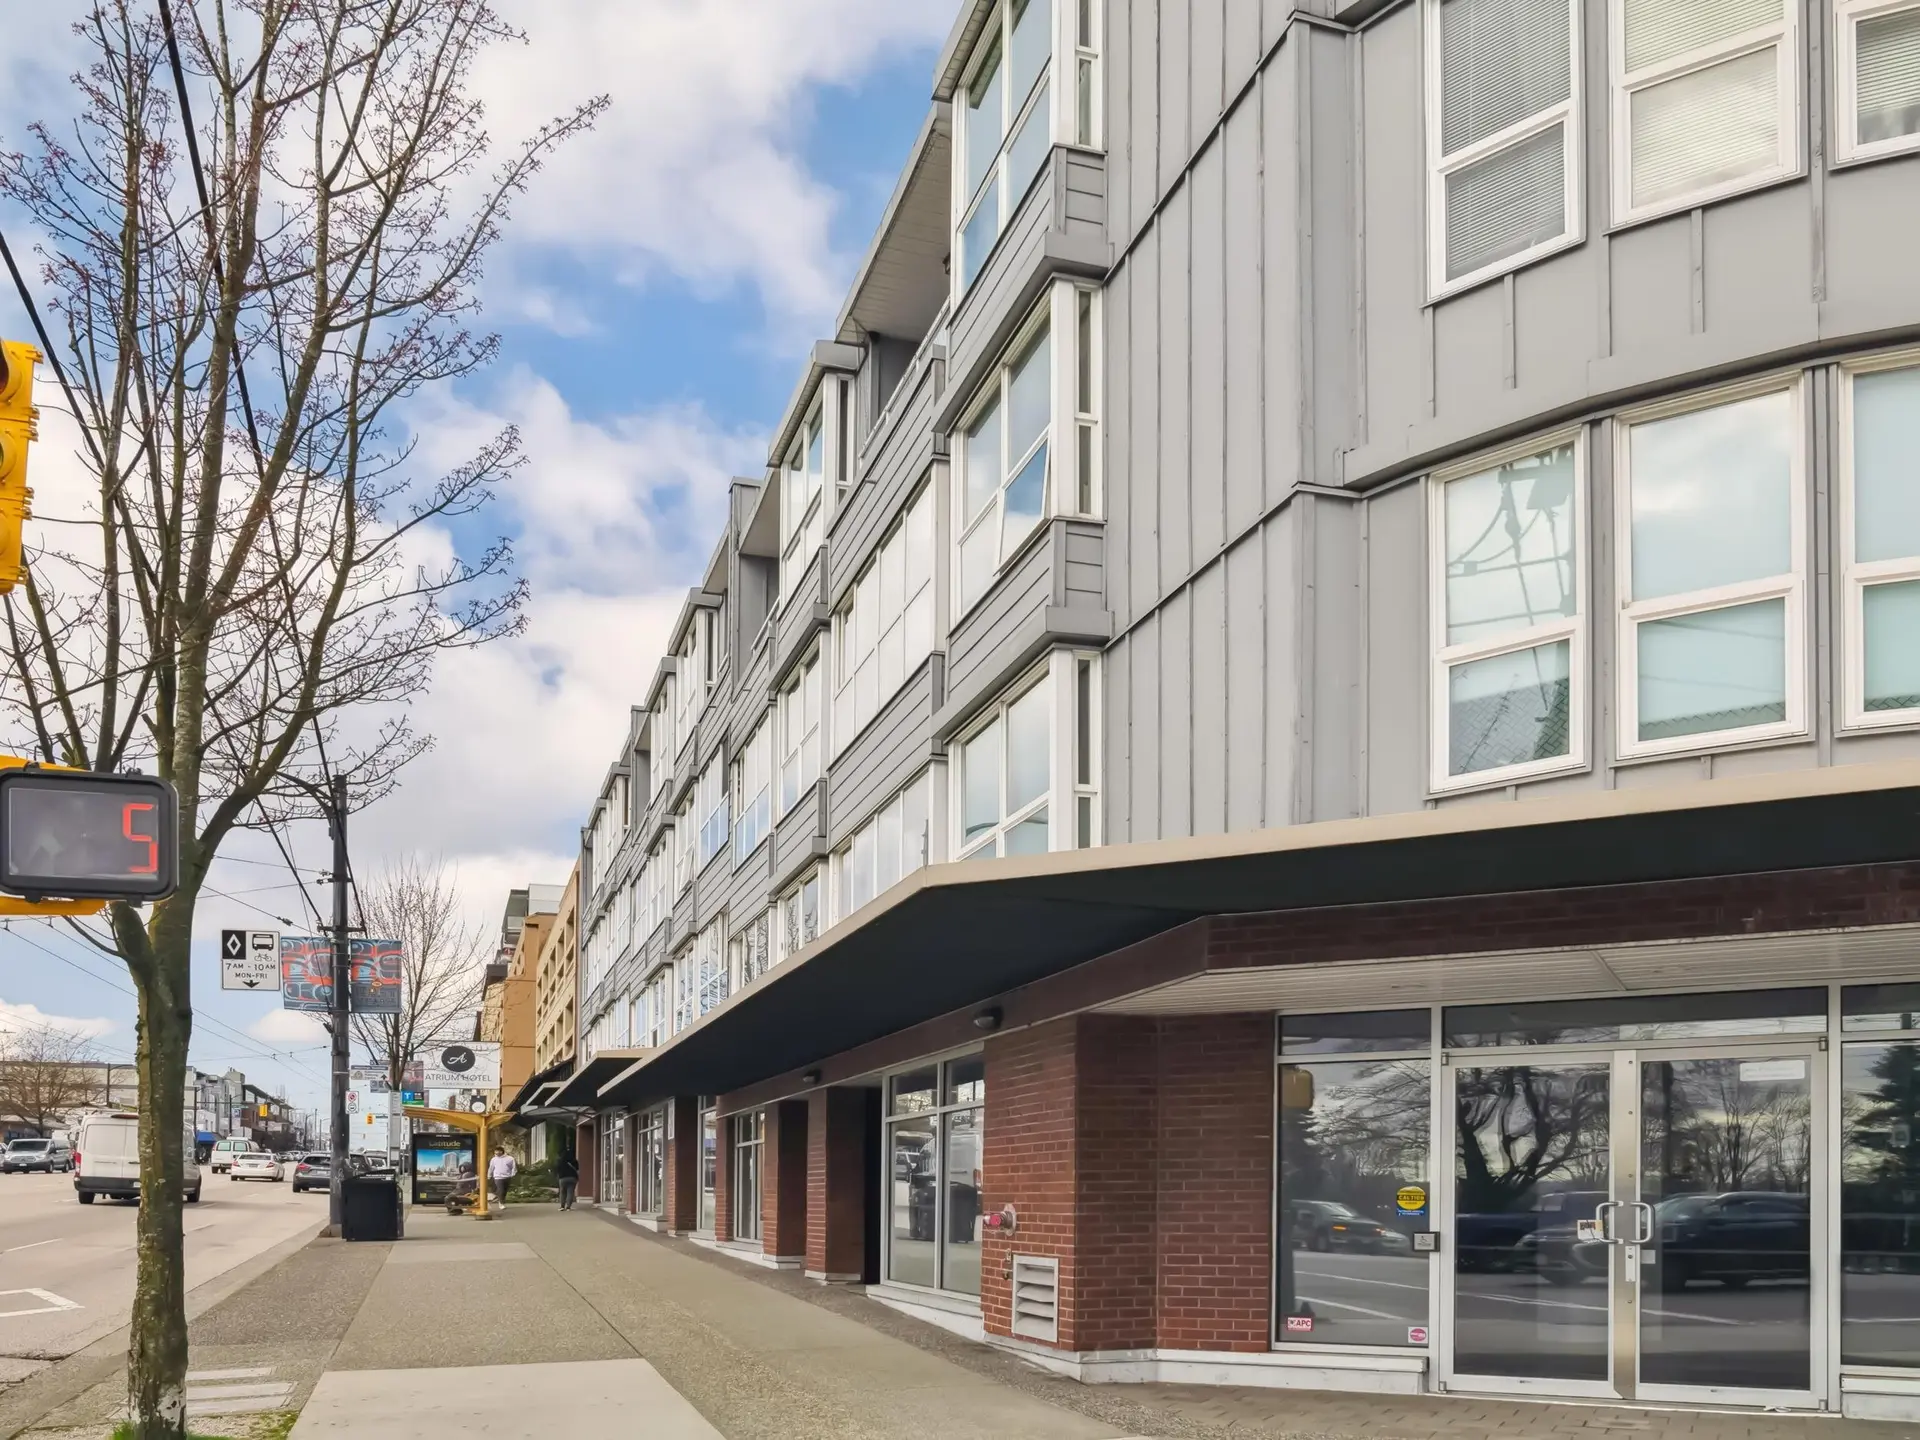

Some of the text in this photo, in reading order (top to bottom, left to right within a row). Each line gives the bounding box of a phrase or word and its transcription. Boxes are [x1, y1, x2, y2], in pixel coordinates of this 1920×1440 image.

[122, 803, 159, 873] 5
[425, 1073, 492, 1082] ATRIUM HOTEL
